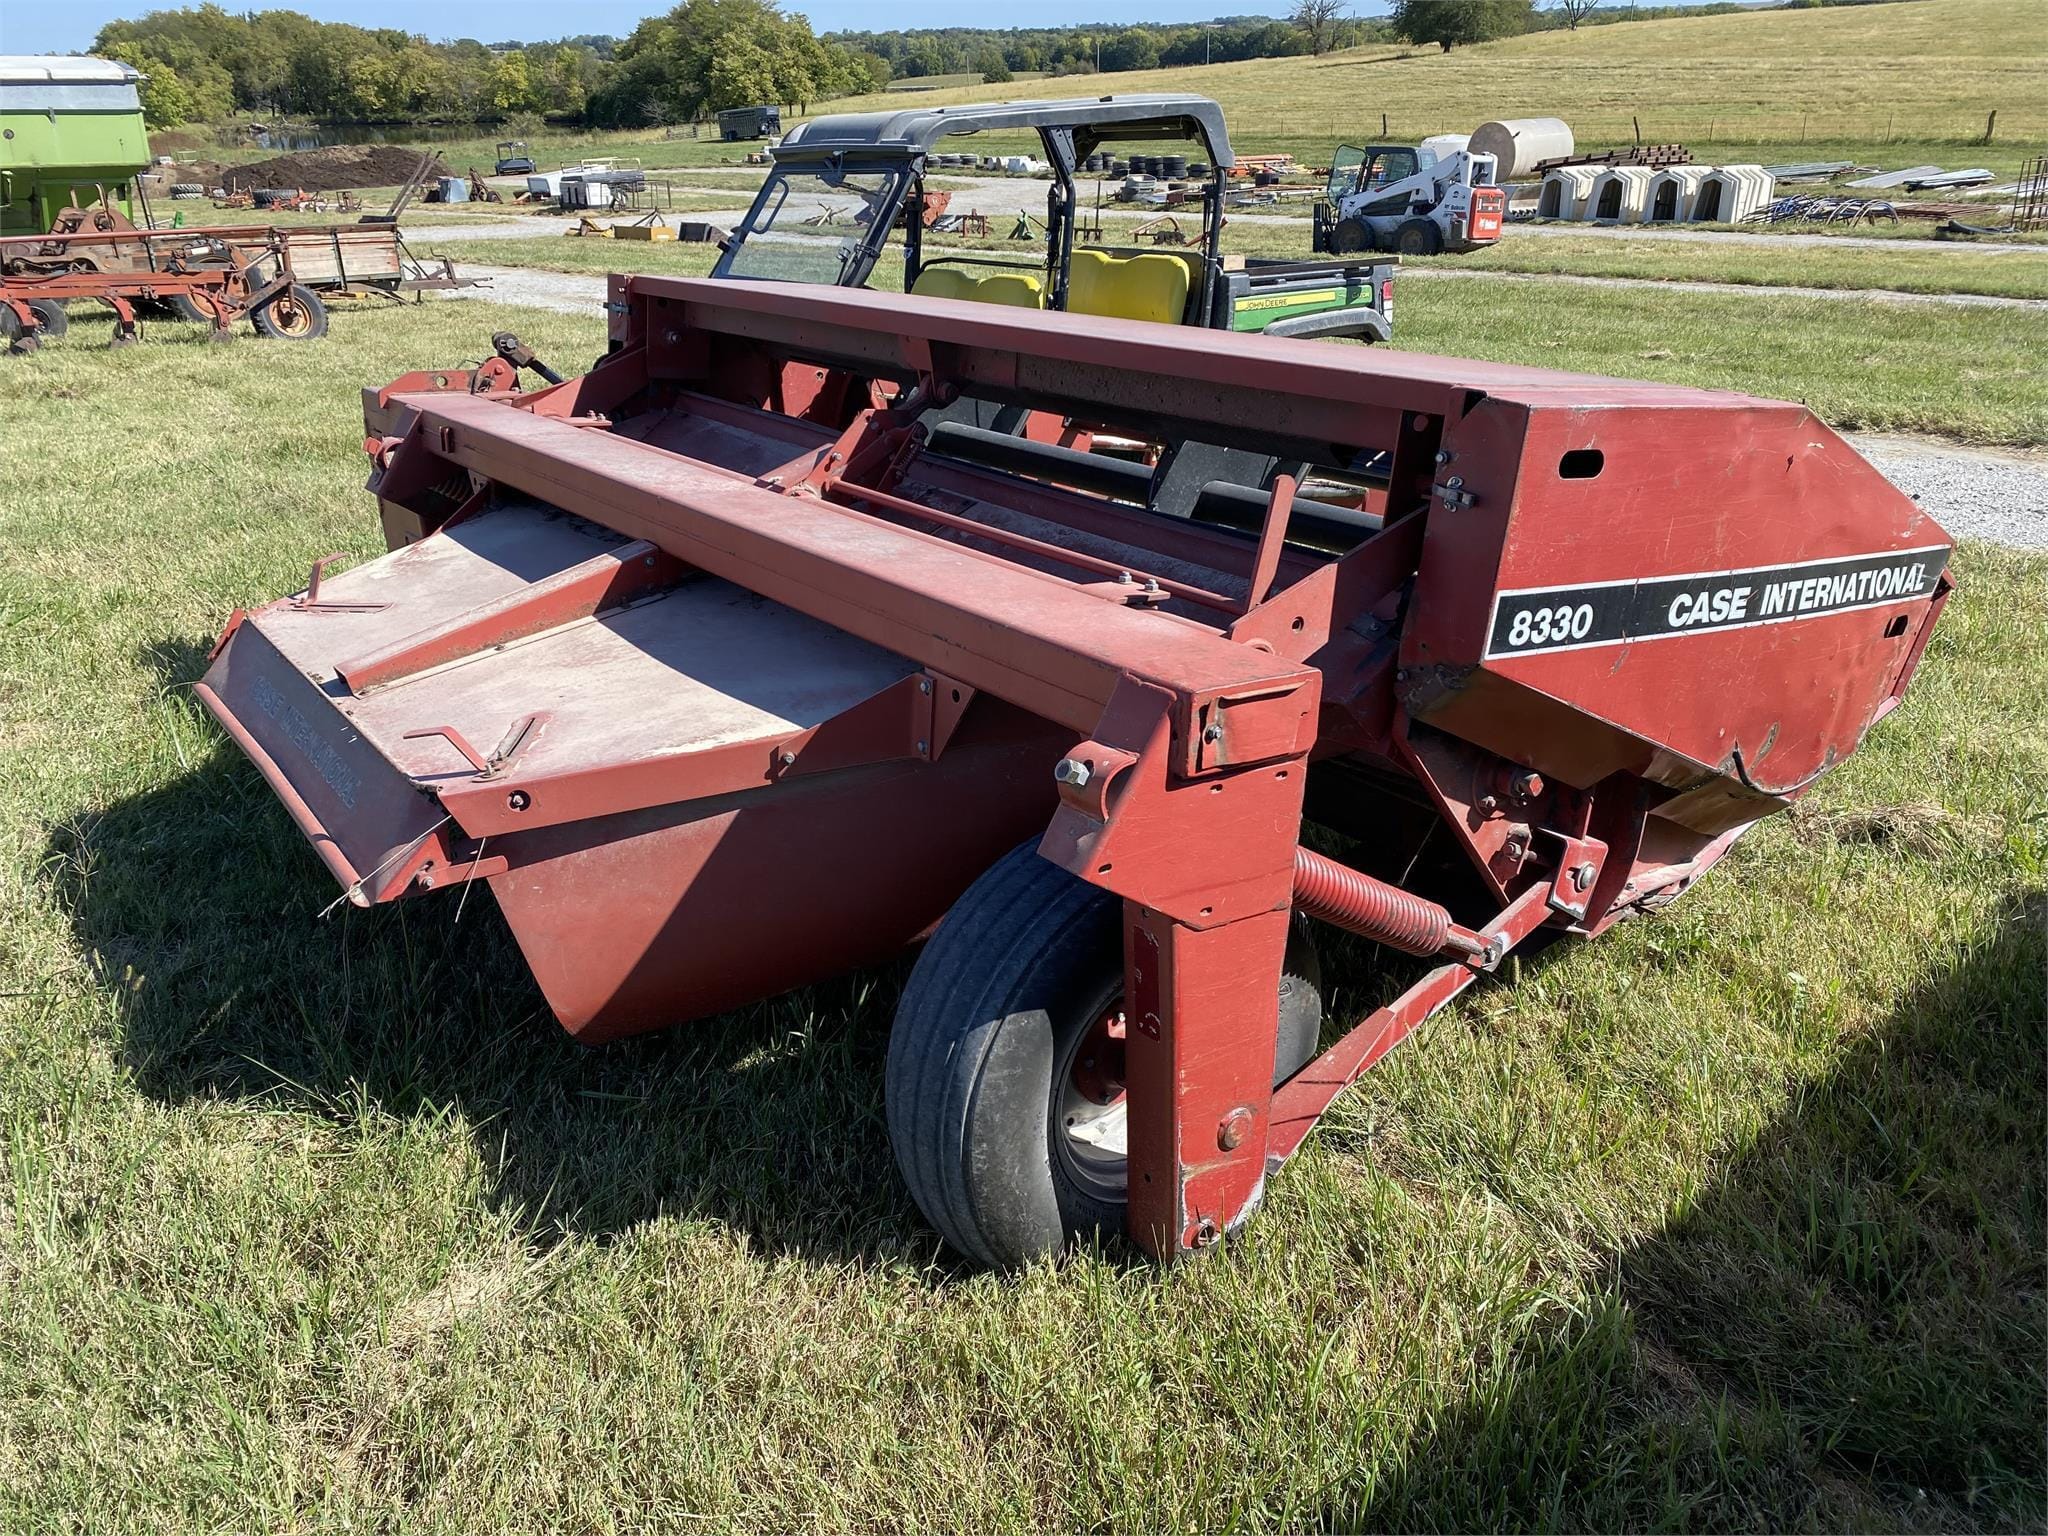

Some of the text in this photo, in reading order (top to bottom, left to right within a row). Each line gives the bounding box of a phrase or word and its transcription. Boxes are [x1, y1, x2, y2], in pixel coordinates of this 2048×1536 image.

[1246, 298, 1287, 309] JOHN DEERE
[1508, 563, 1925, 646] 8330 CASE INTERNATIONAL
